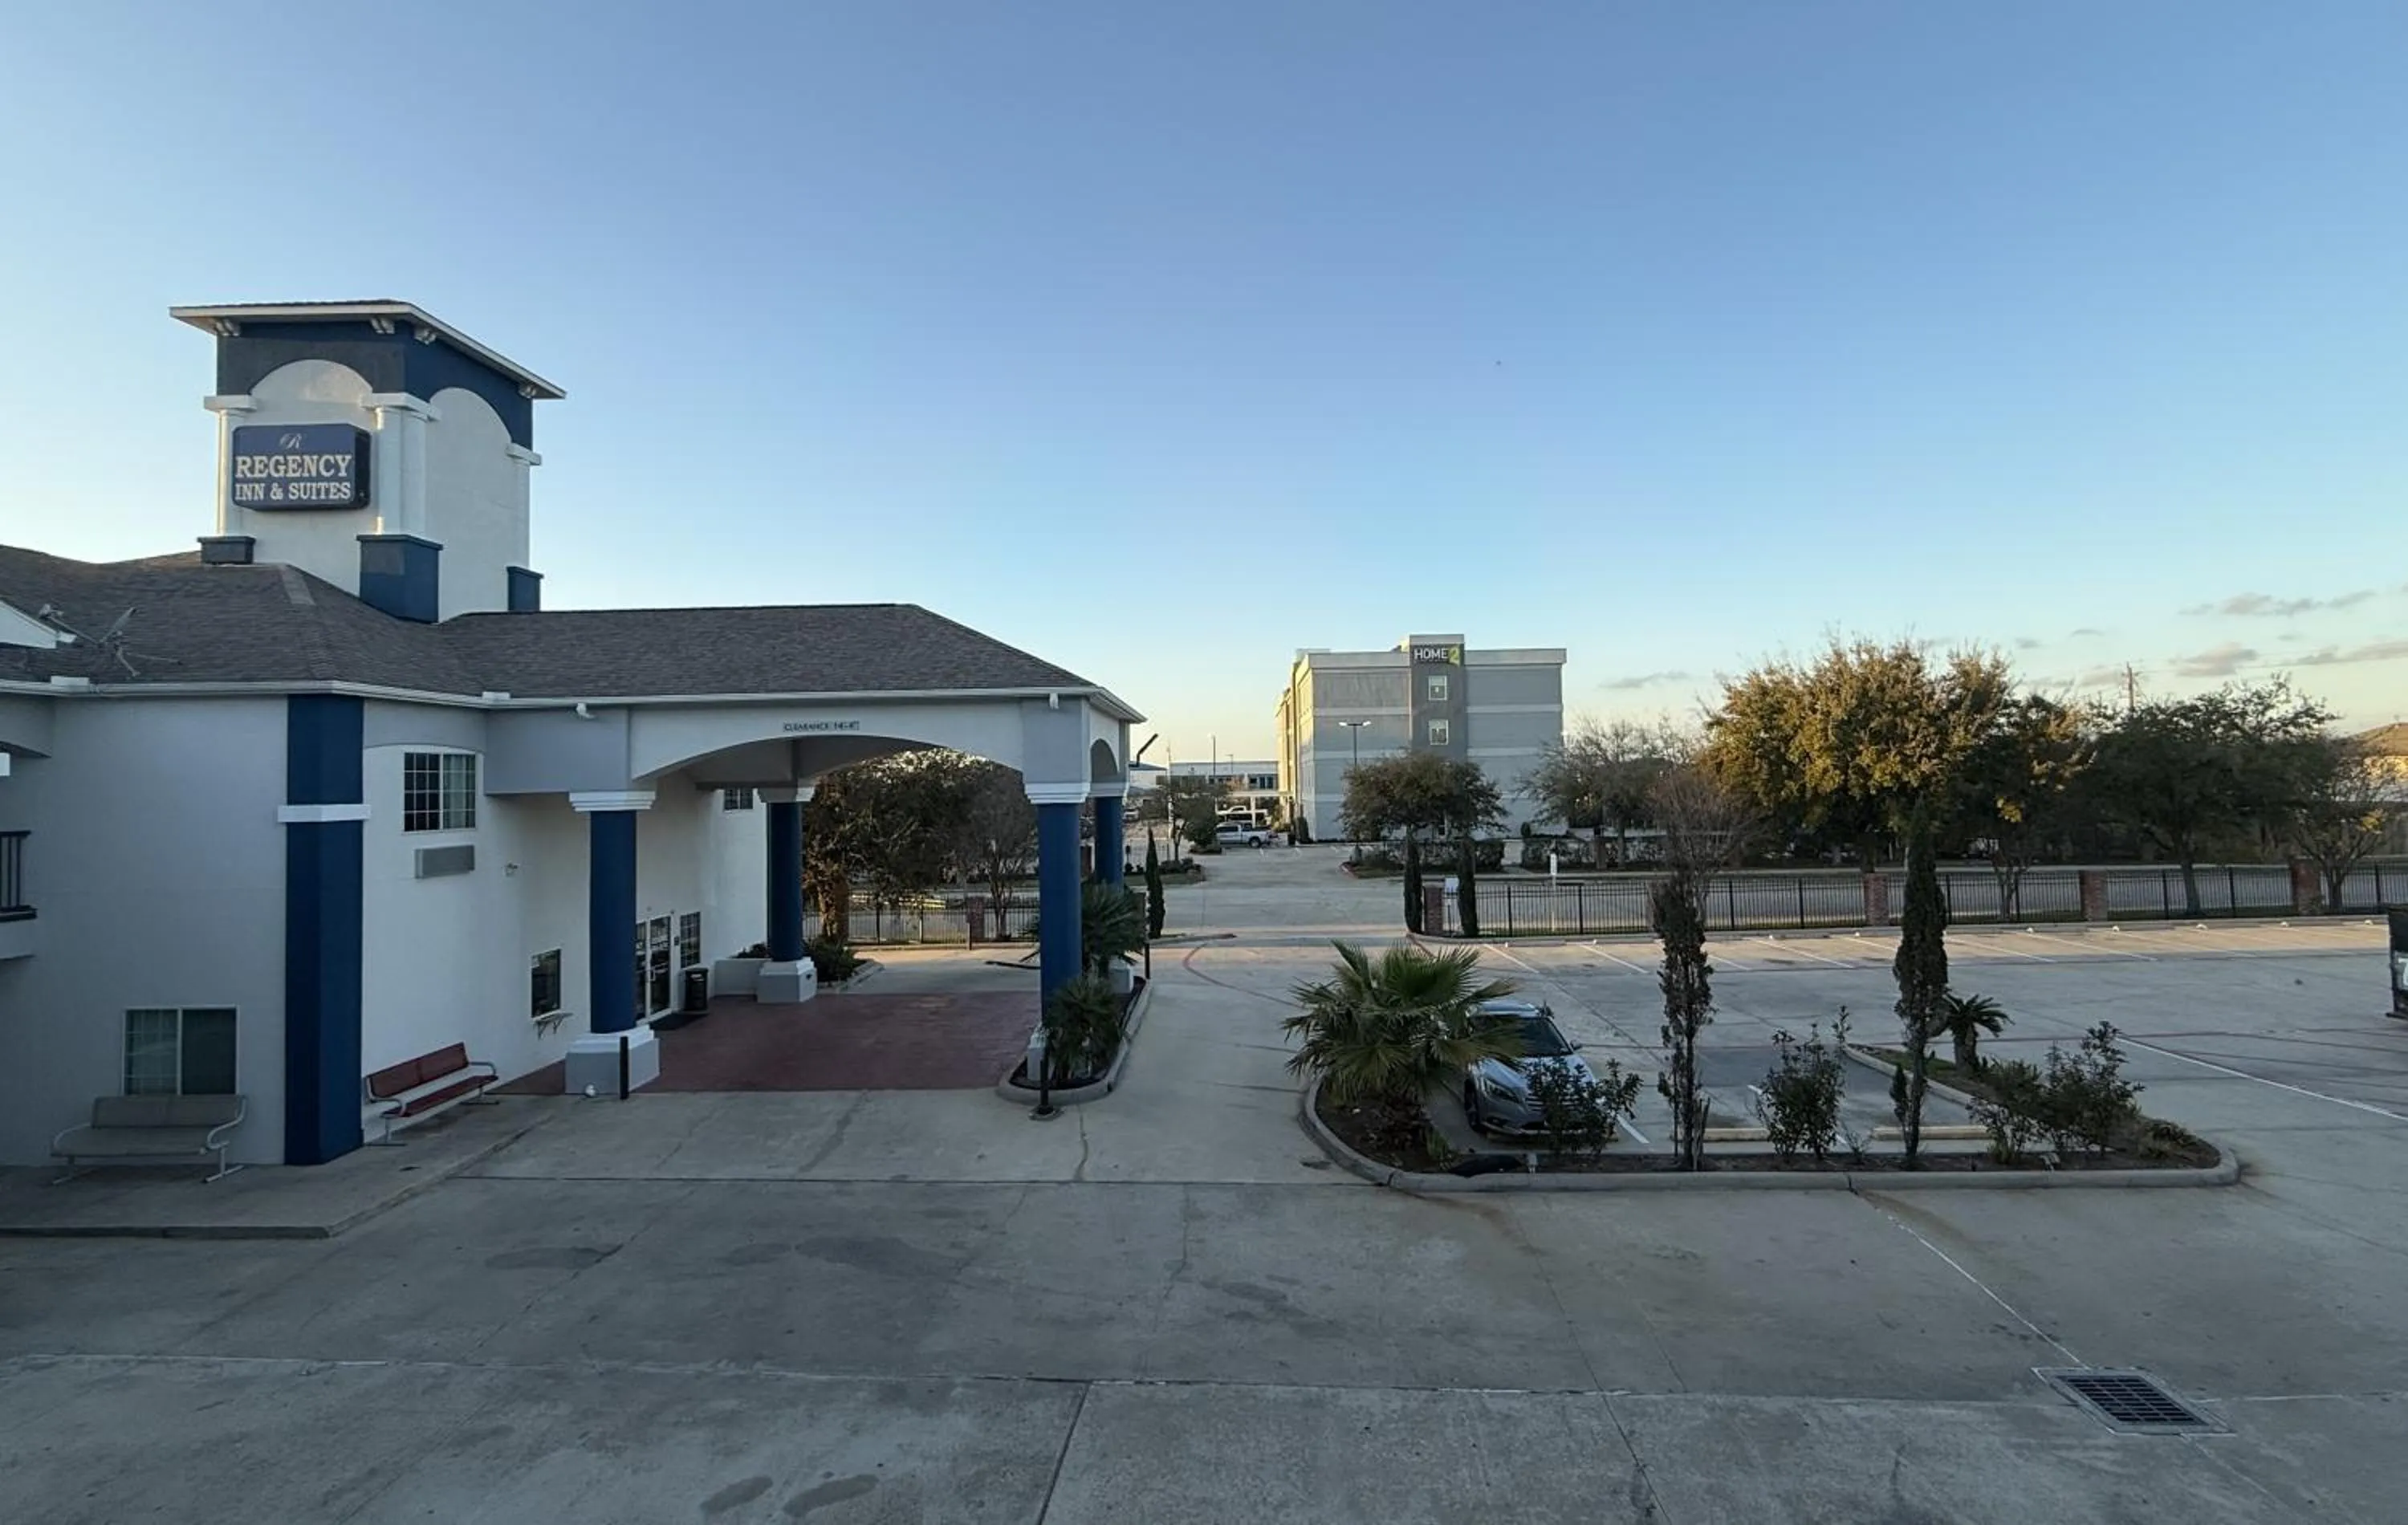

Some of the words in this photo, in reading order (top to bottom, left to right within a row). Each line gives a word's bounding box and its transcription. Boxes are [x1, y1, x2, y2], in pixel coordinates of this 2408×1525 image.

[235, 454, 352, 478] REGENCY
[235, 483, 265, 501] INN
[270, 482, 283, 500] &
[288, 482, 351, 499] SUITES
